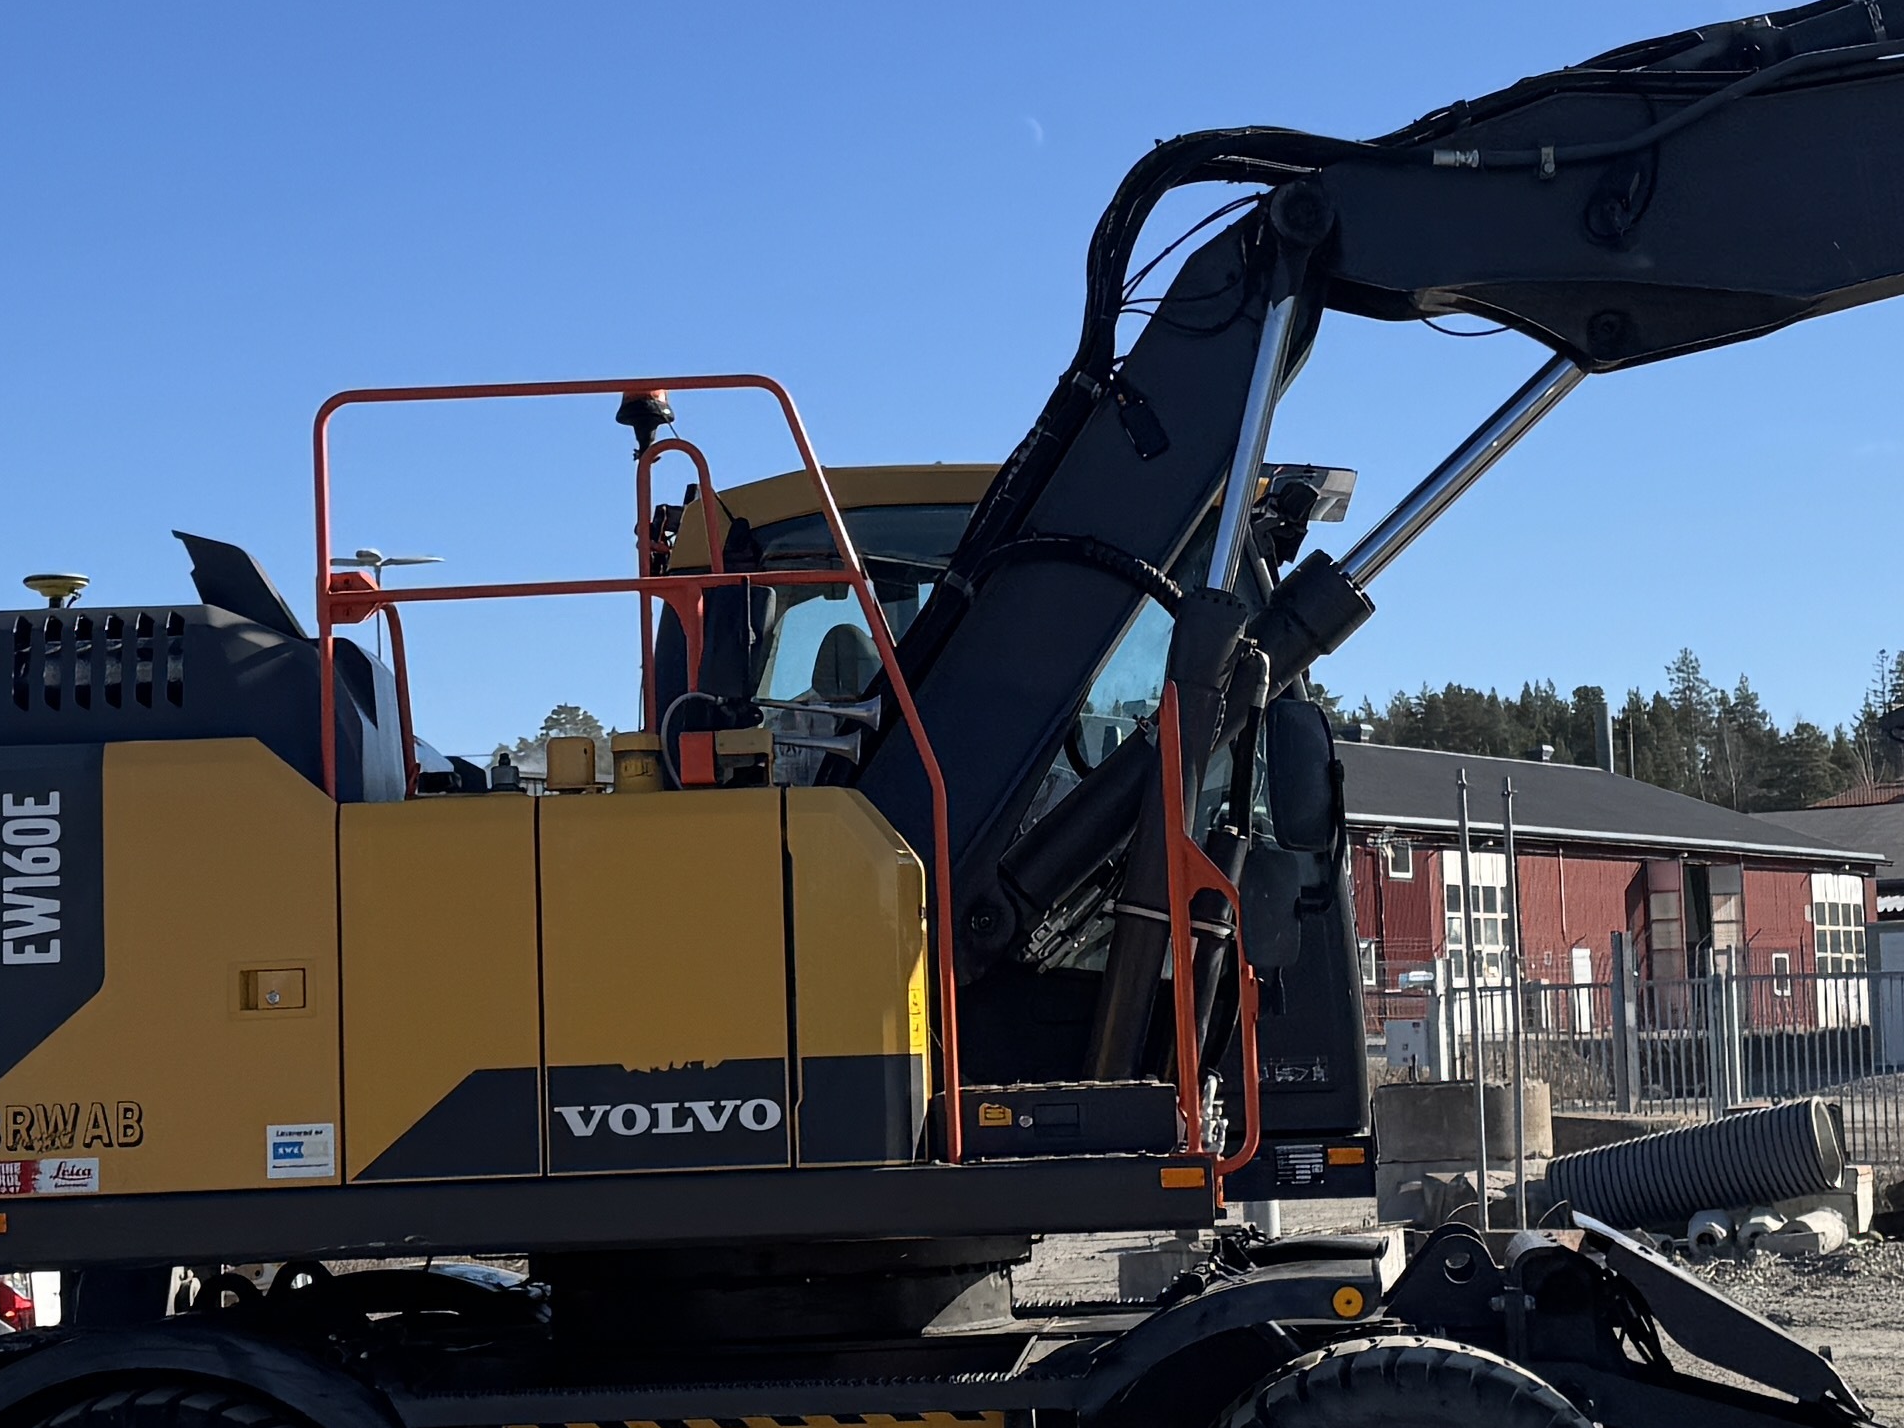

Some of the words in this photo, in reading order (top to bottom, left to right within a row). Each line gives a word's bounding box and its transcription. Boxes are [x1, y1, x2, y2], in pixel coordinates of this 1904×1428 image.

[2, 791, 61, 965] EW160E
[553, 1098, 782, 1137] VOLVO
[49, 1161, 93, 1181] Leica
